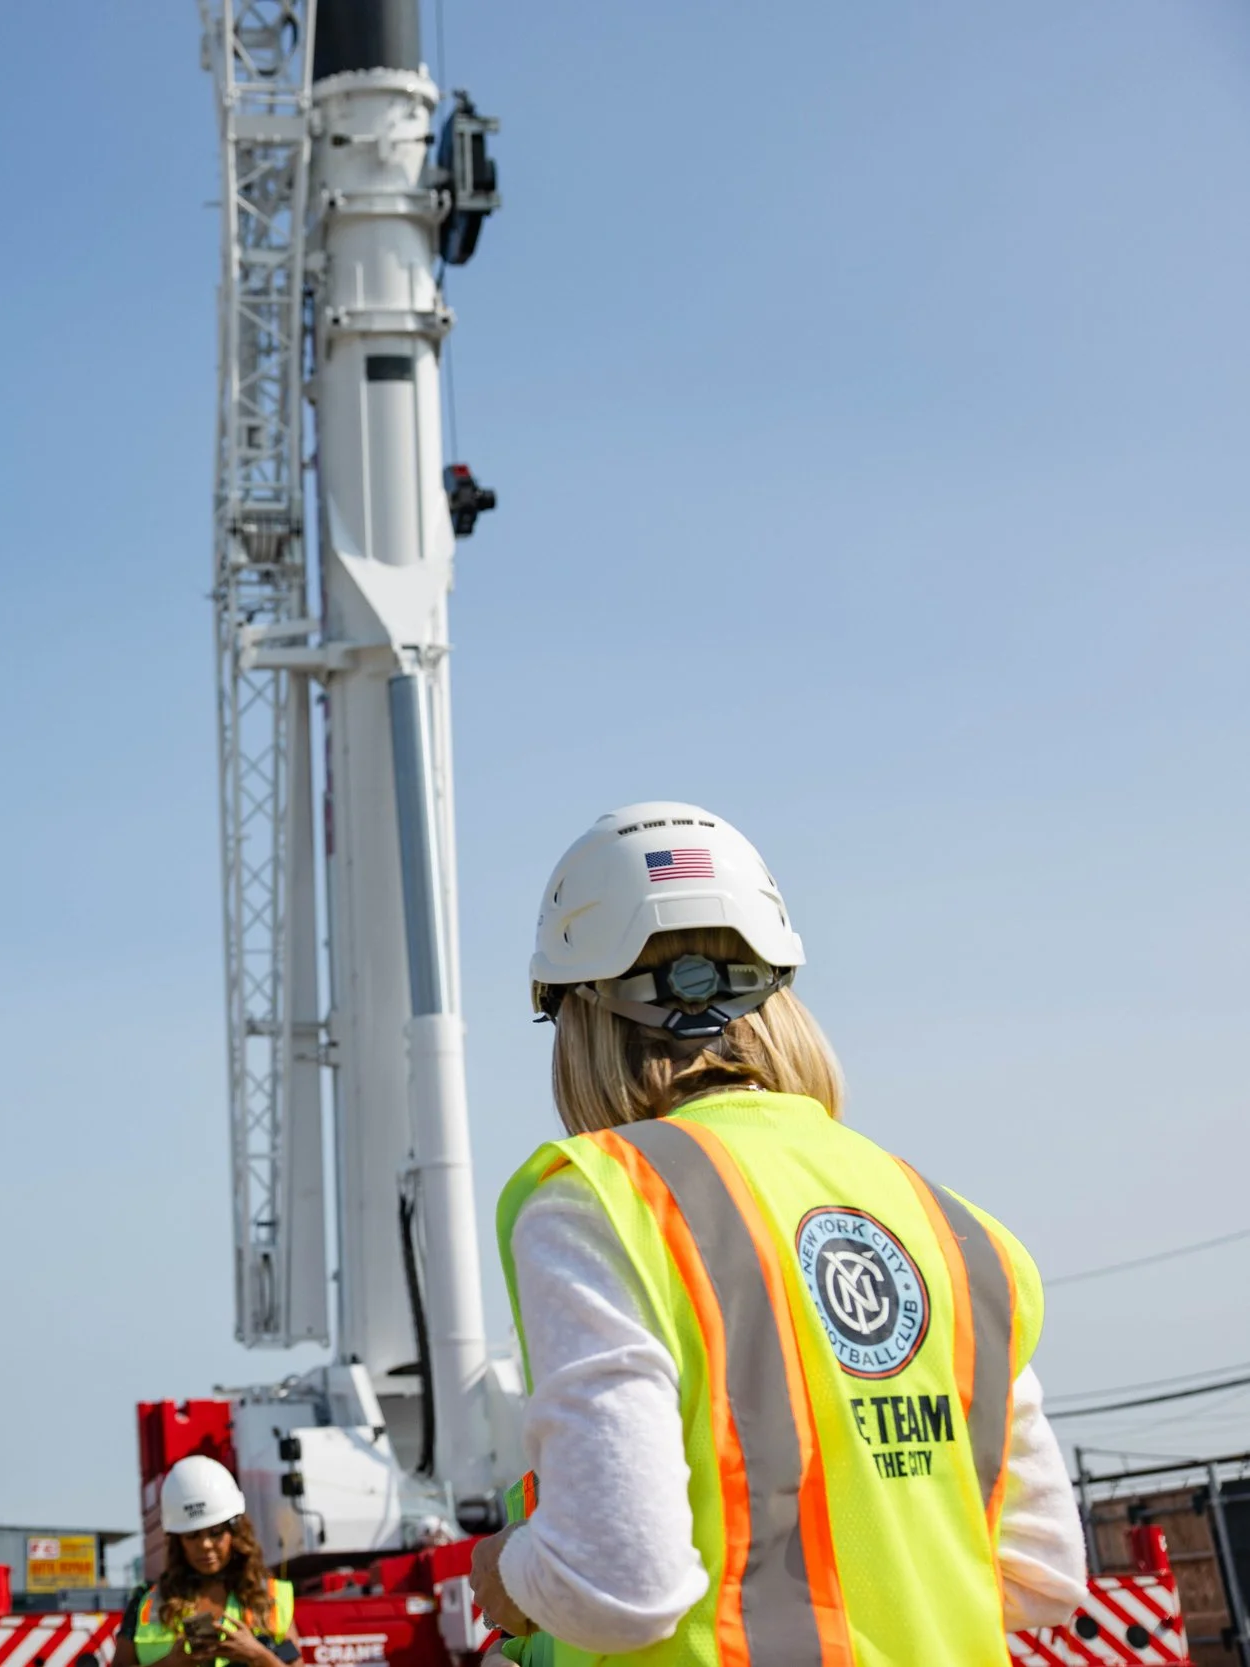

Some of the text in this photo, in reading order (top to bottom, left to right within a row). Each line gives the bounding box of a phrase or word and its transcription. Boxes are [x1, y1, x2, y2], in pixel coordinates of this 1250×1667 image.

[803, 1219, 909, 1275] NEW YORK CITY
[895, 1299, 918, 1352] CLUB
[870, 1395, 955, 1444] TEAM
[873, 1451, 908, 1479] THE
